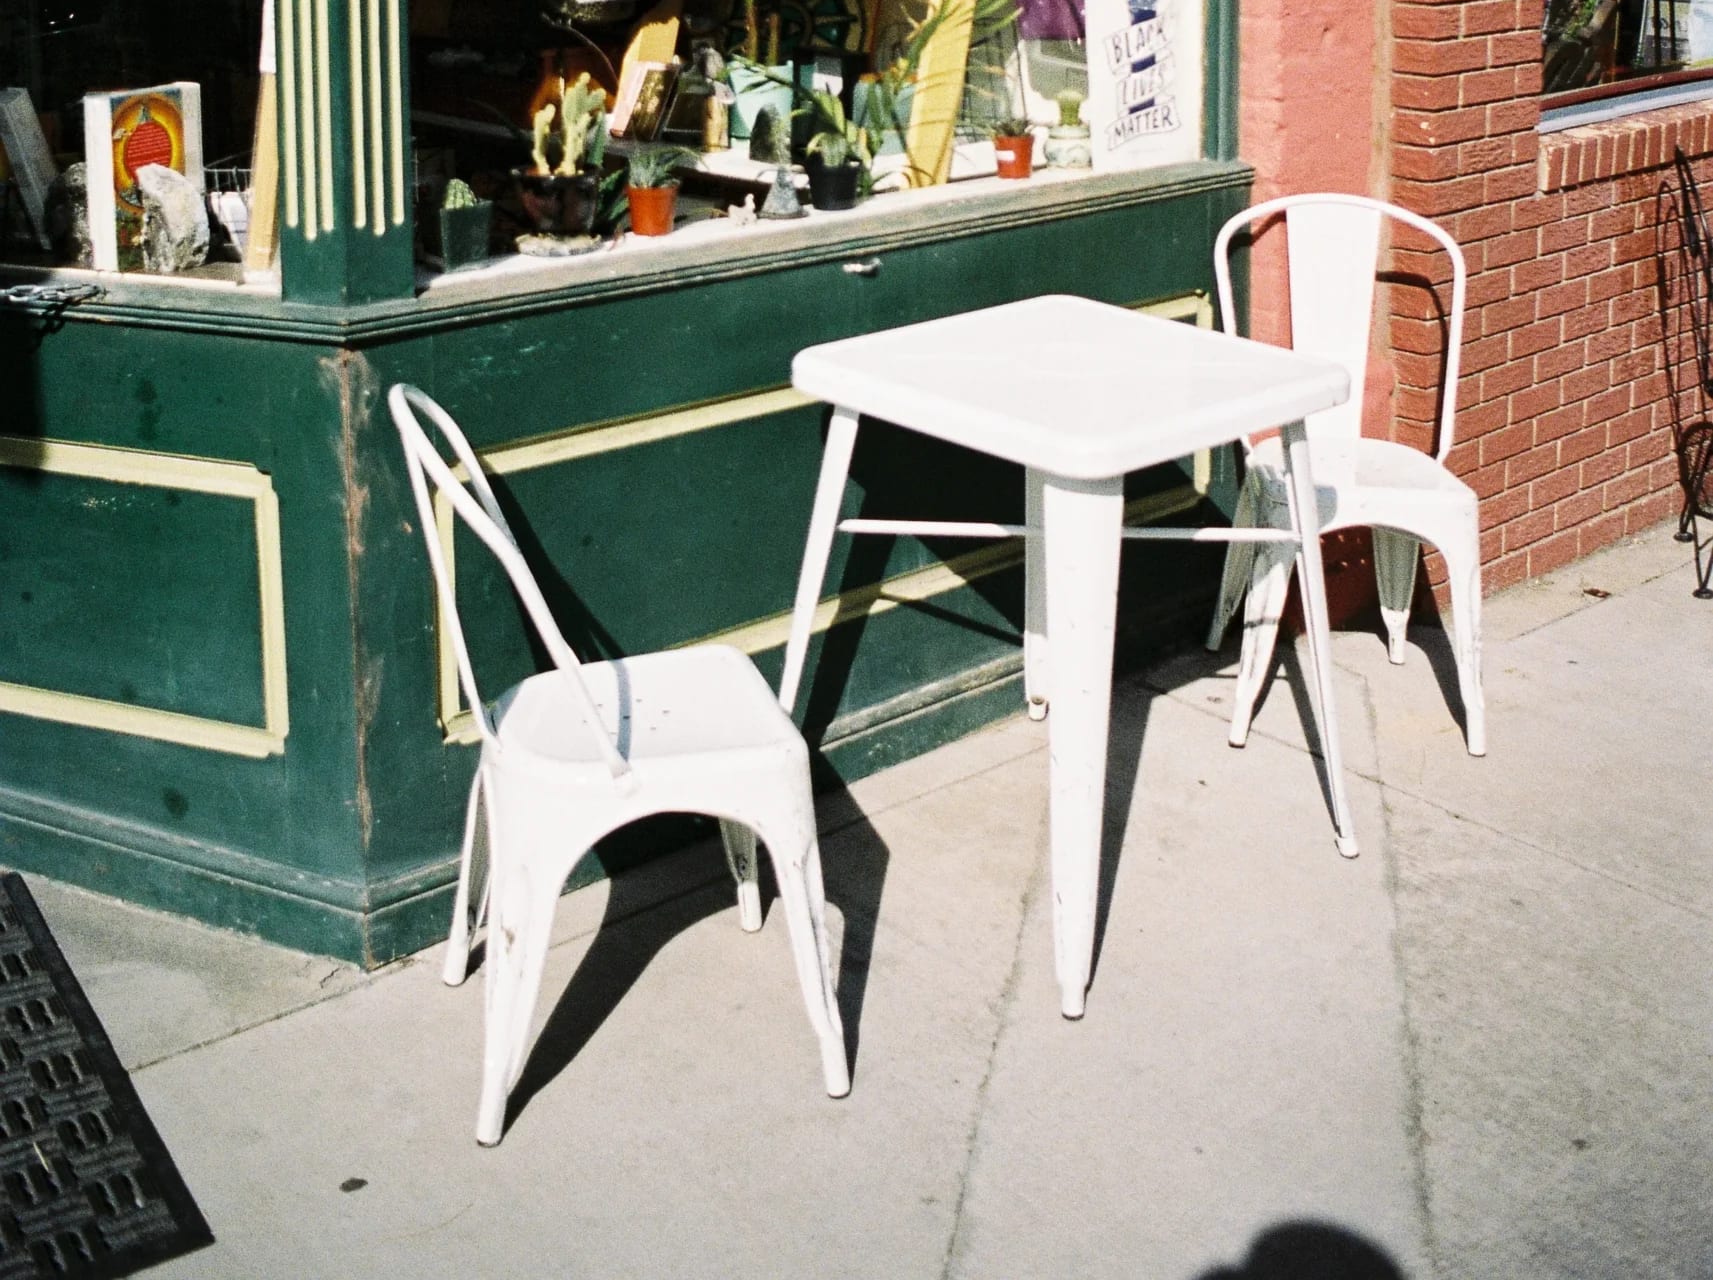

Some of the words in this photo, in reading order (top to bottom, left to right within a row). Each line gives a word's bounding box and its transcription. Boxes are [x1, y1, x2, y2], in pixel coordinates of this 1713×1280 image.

[1110, 17, 1168, 64] BLACK
[1121, 63, 1166, 106] LIVES
[1112, 104, 1174, 141] MATTER
